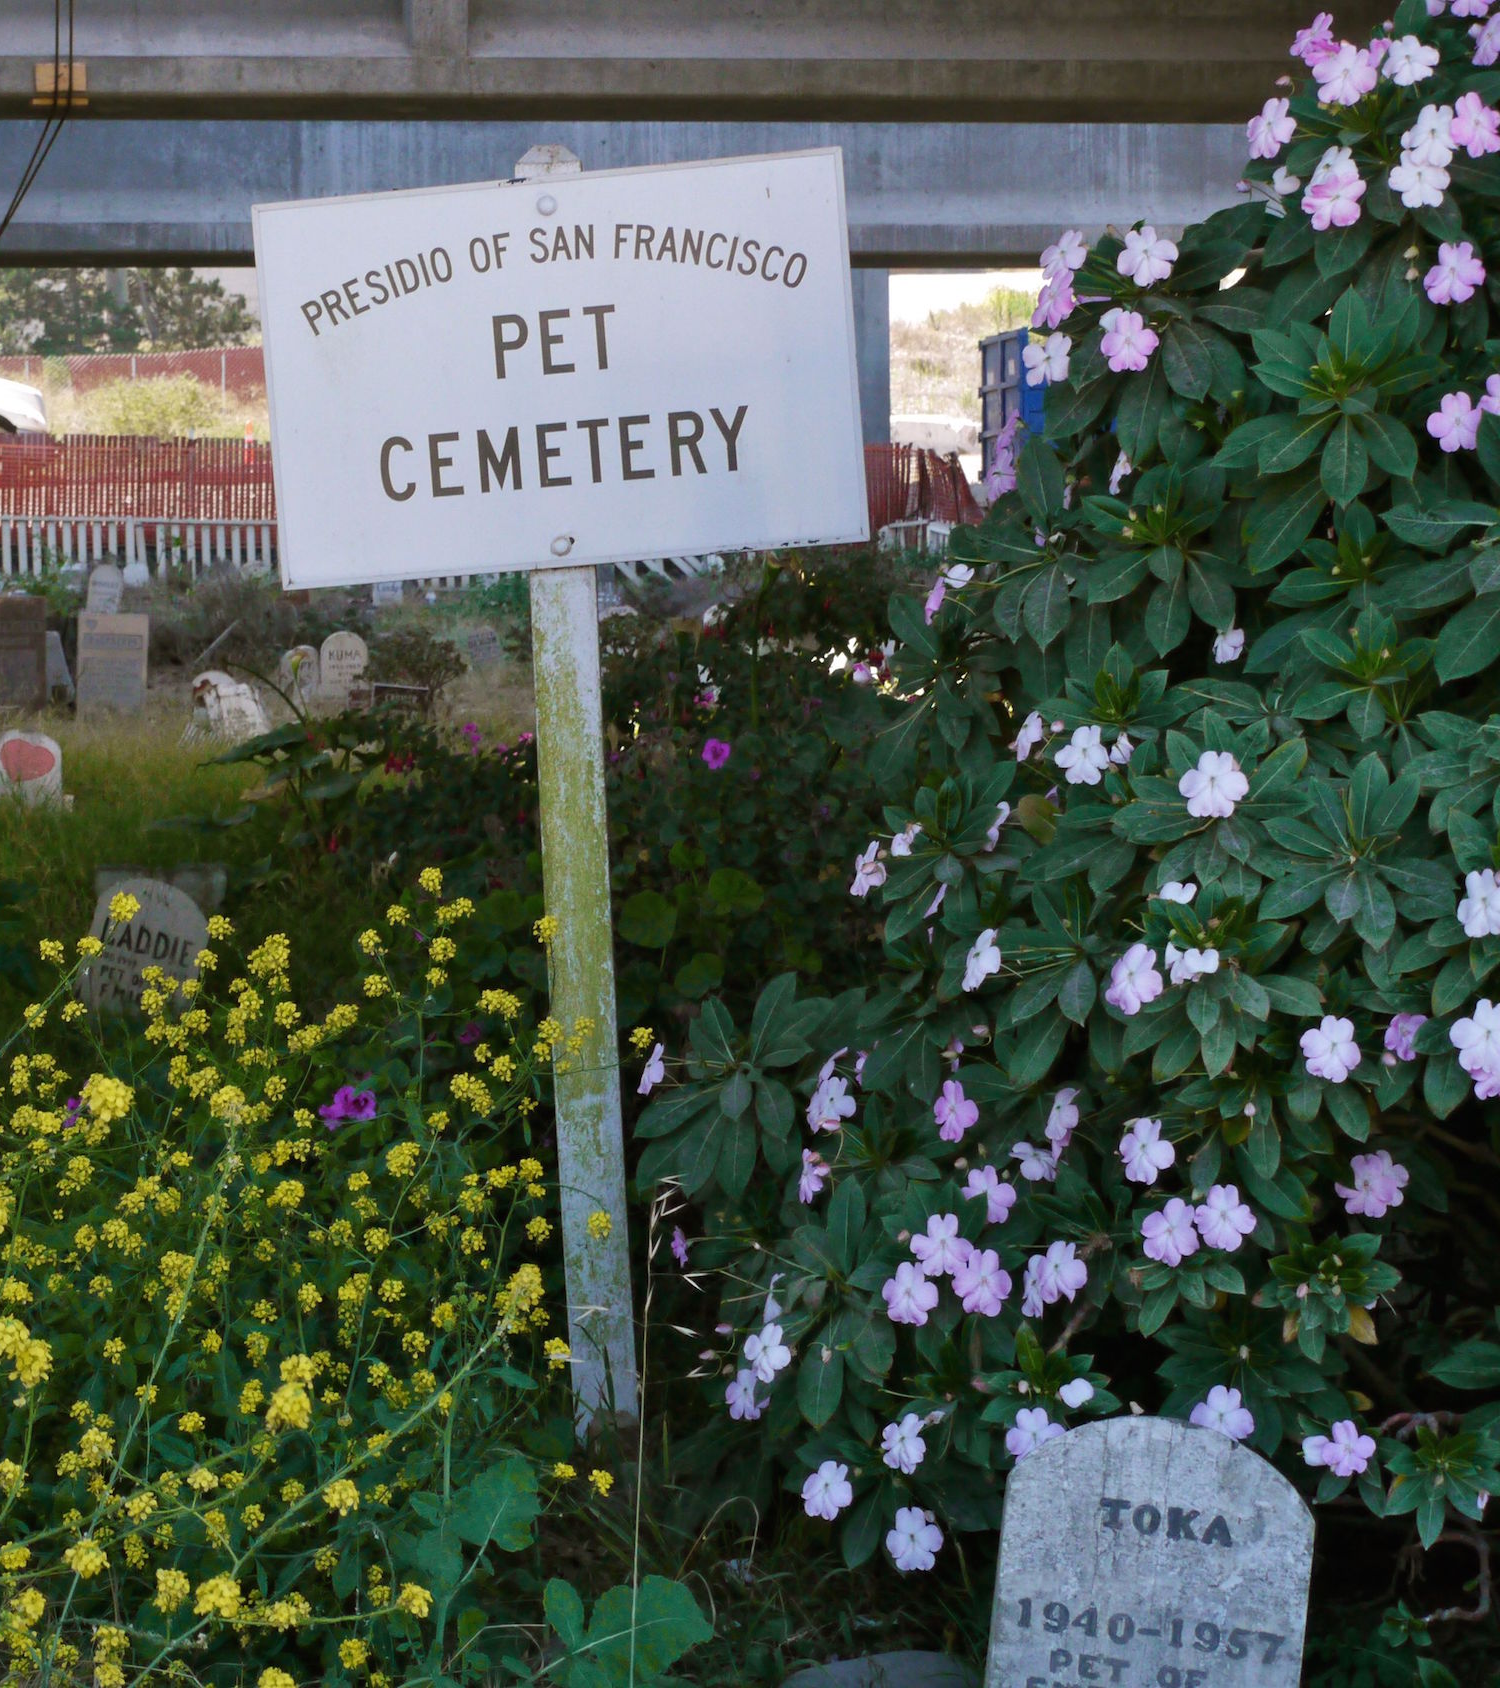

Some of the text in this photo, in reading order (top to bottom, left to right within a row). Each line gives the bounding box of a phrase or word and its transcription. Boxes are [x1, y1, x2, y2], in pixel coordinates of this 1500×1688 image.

[301, 224, 808, 336] PRESIDIO OF SAN FRANCISCO
[492, 304, 616, 380] PET
[380, 405, 749, 502] CEMETERY
[328, 649, 362, 662] KUMA
[100, 916, 194, 968] LADDIE
[1100, 1497, 1233, 1548] TOKA
[1017, 1597, 1286, 1664] 1940-1957
[1049, 1648, 1131, 1683] PET
[1156, 1664, 1209, 1688] OF
